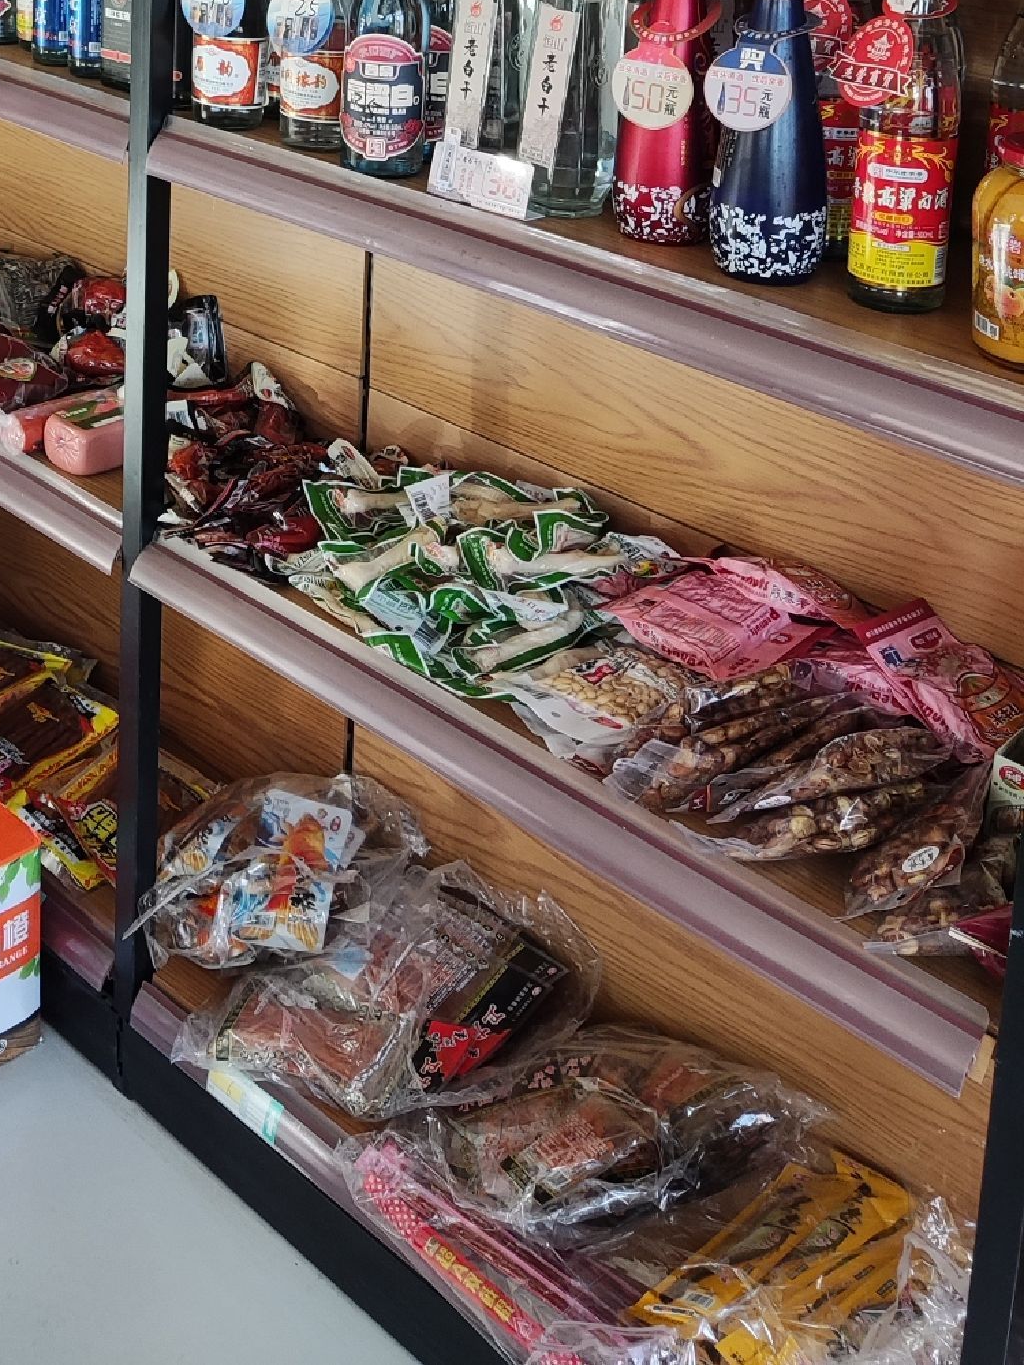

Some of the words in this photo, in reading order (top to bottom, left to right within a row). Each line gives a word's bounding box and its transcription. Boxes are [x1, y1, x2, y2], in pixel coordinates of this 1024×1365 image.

[460, 38, 479, 101] 老白干
[537, 54, 559, 116] 老白干
